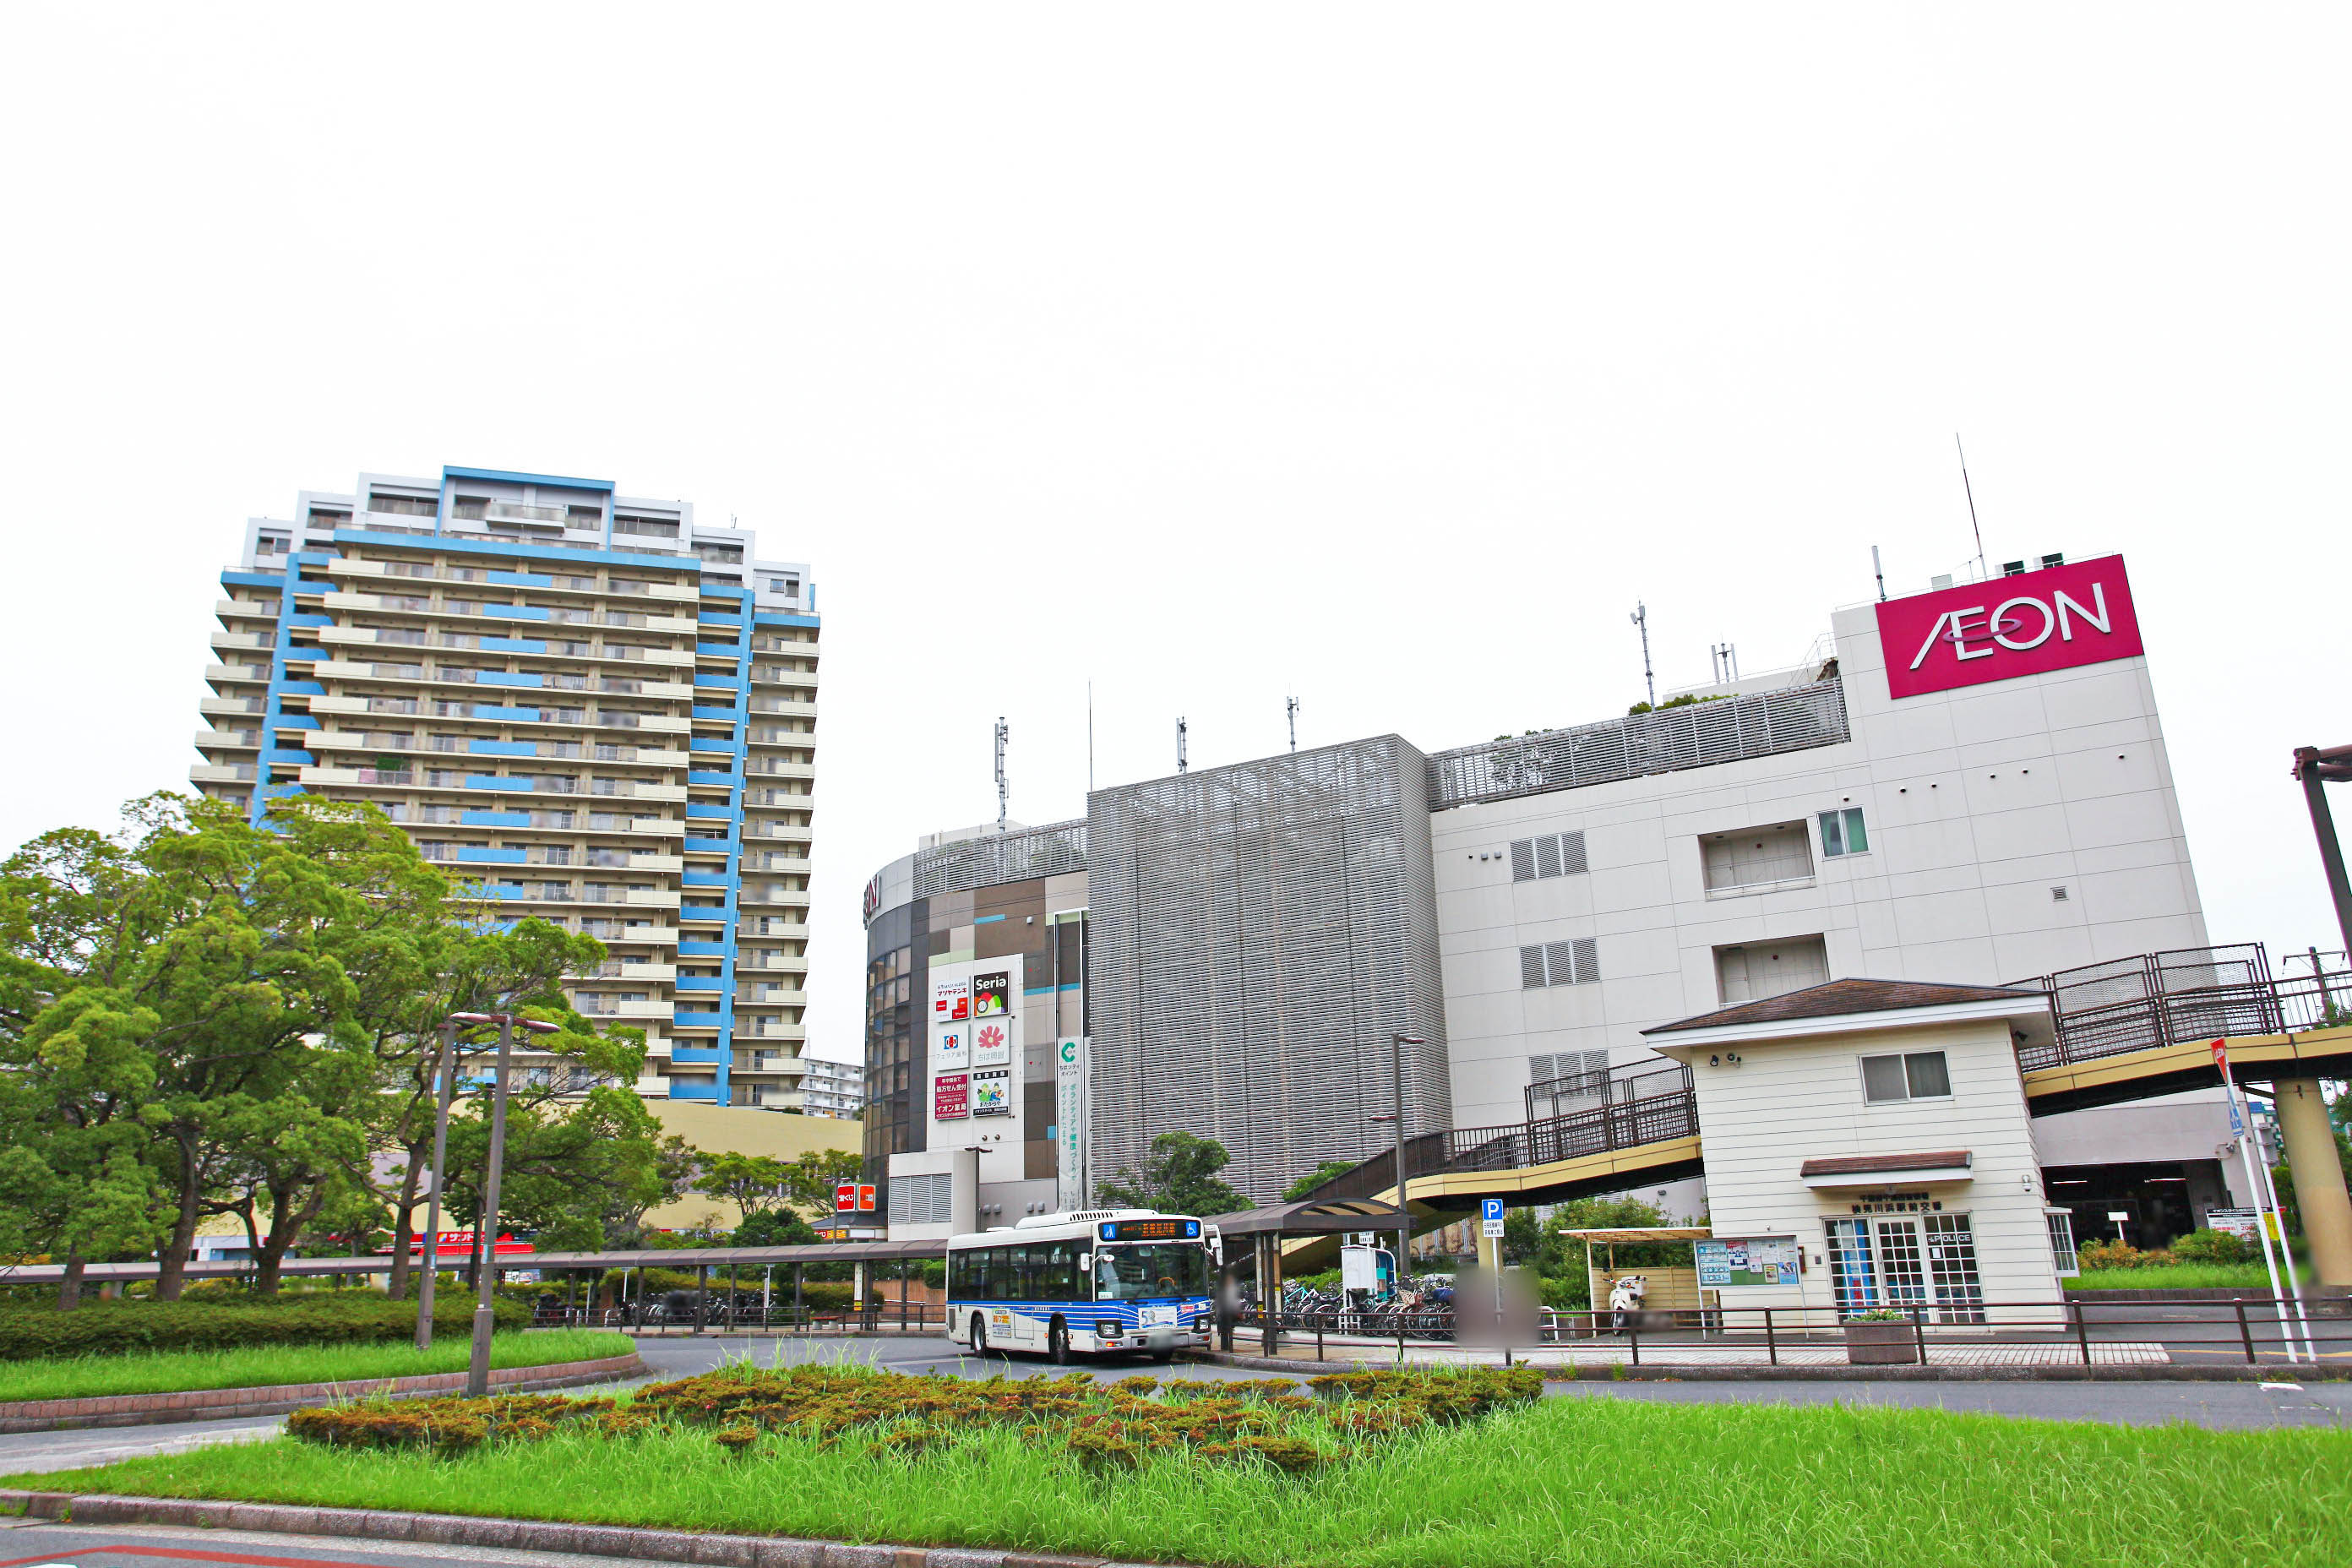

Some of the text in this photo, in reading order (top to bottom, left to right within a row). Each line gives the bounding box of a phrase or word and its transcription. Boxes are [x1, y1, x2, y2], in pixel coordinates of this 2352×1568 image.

[976, 976, 1007, 990] Seria
[1487, 1201, 1500, 1219] P
[1933, 1234, 1971, 1243] POLICE
